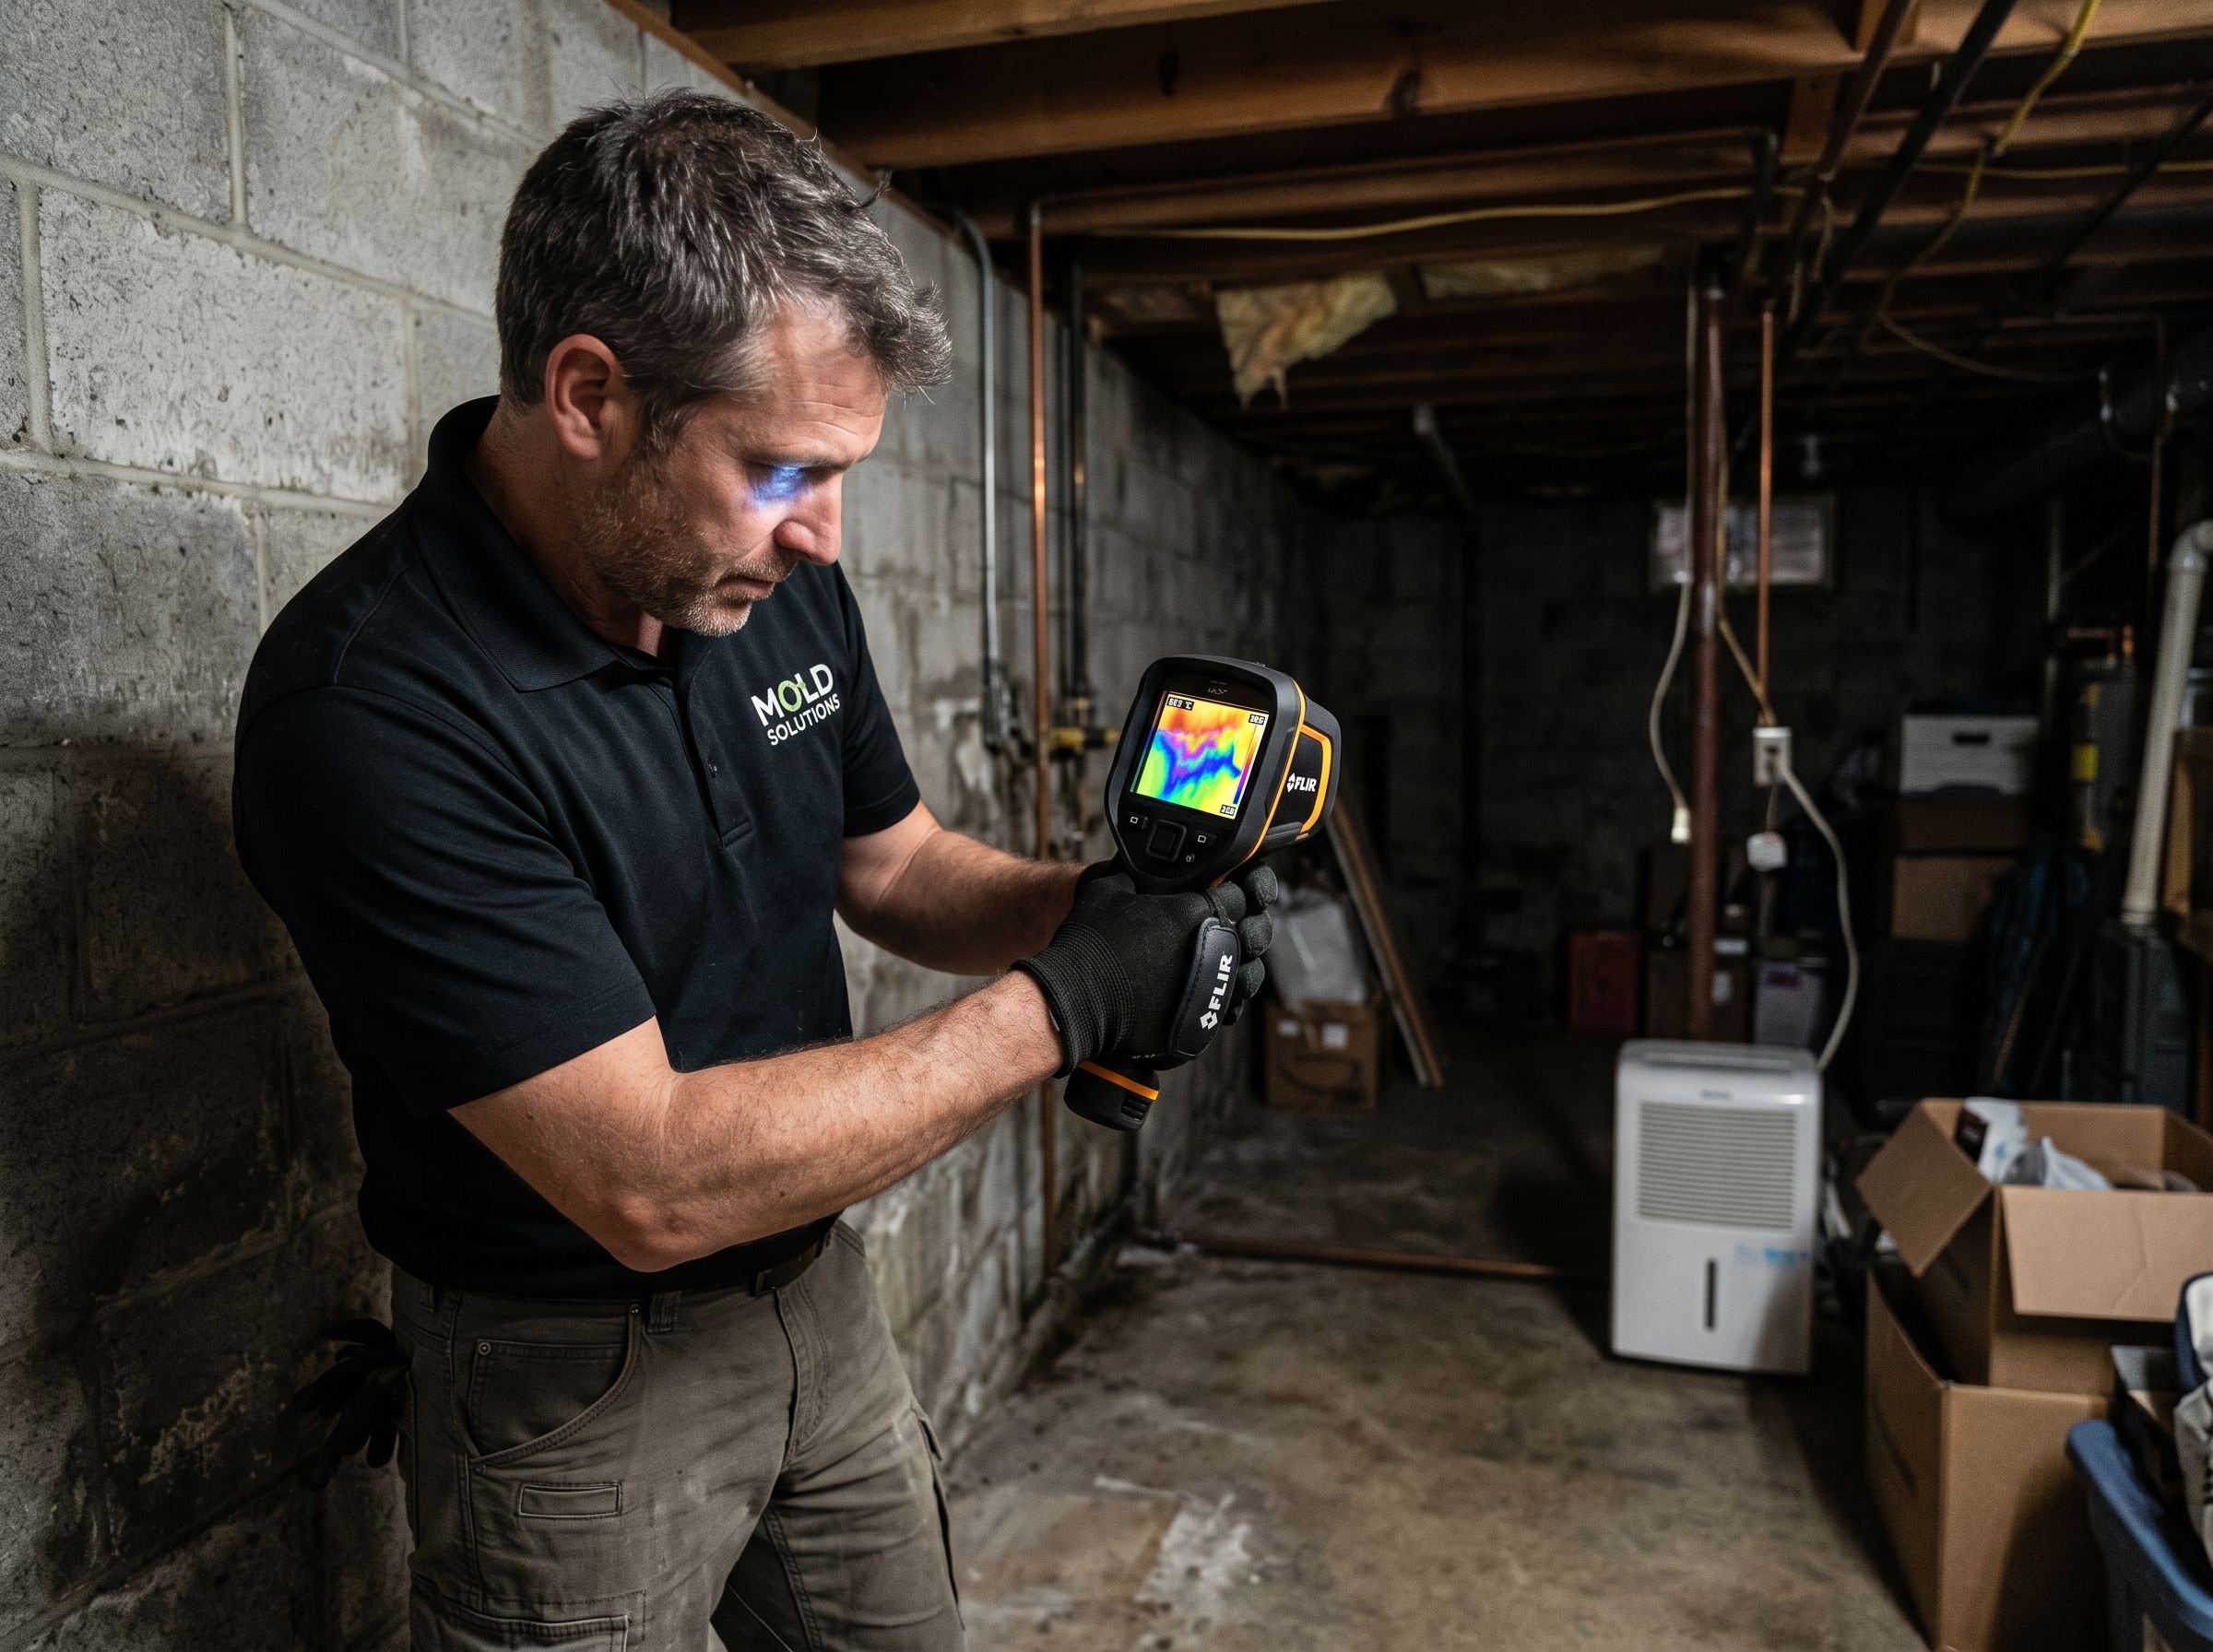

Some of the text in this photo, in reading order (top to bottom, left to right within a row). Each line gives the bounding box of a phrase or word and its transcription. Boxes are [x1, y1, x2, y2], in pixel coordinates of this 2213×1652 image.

[751, 664, 834, 726] MOLD
[767, 693, 841, 746] SOLUTIONS
[1294, 776, 1317, 792] FLIR
[1208, 954, 1233, 1010] FLIR
